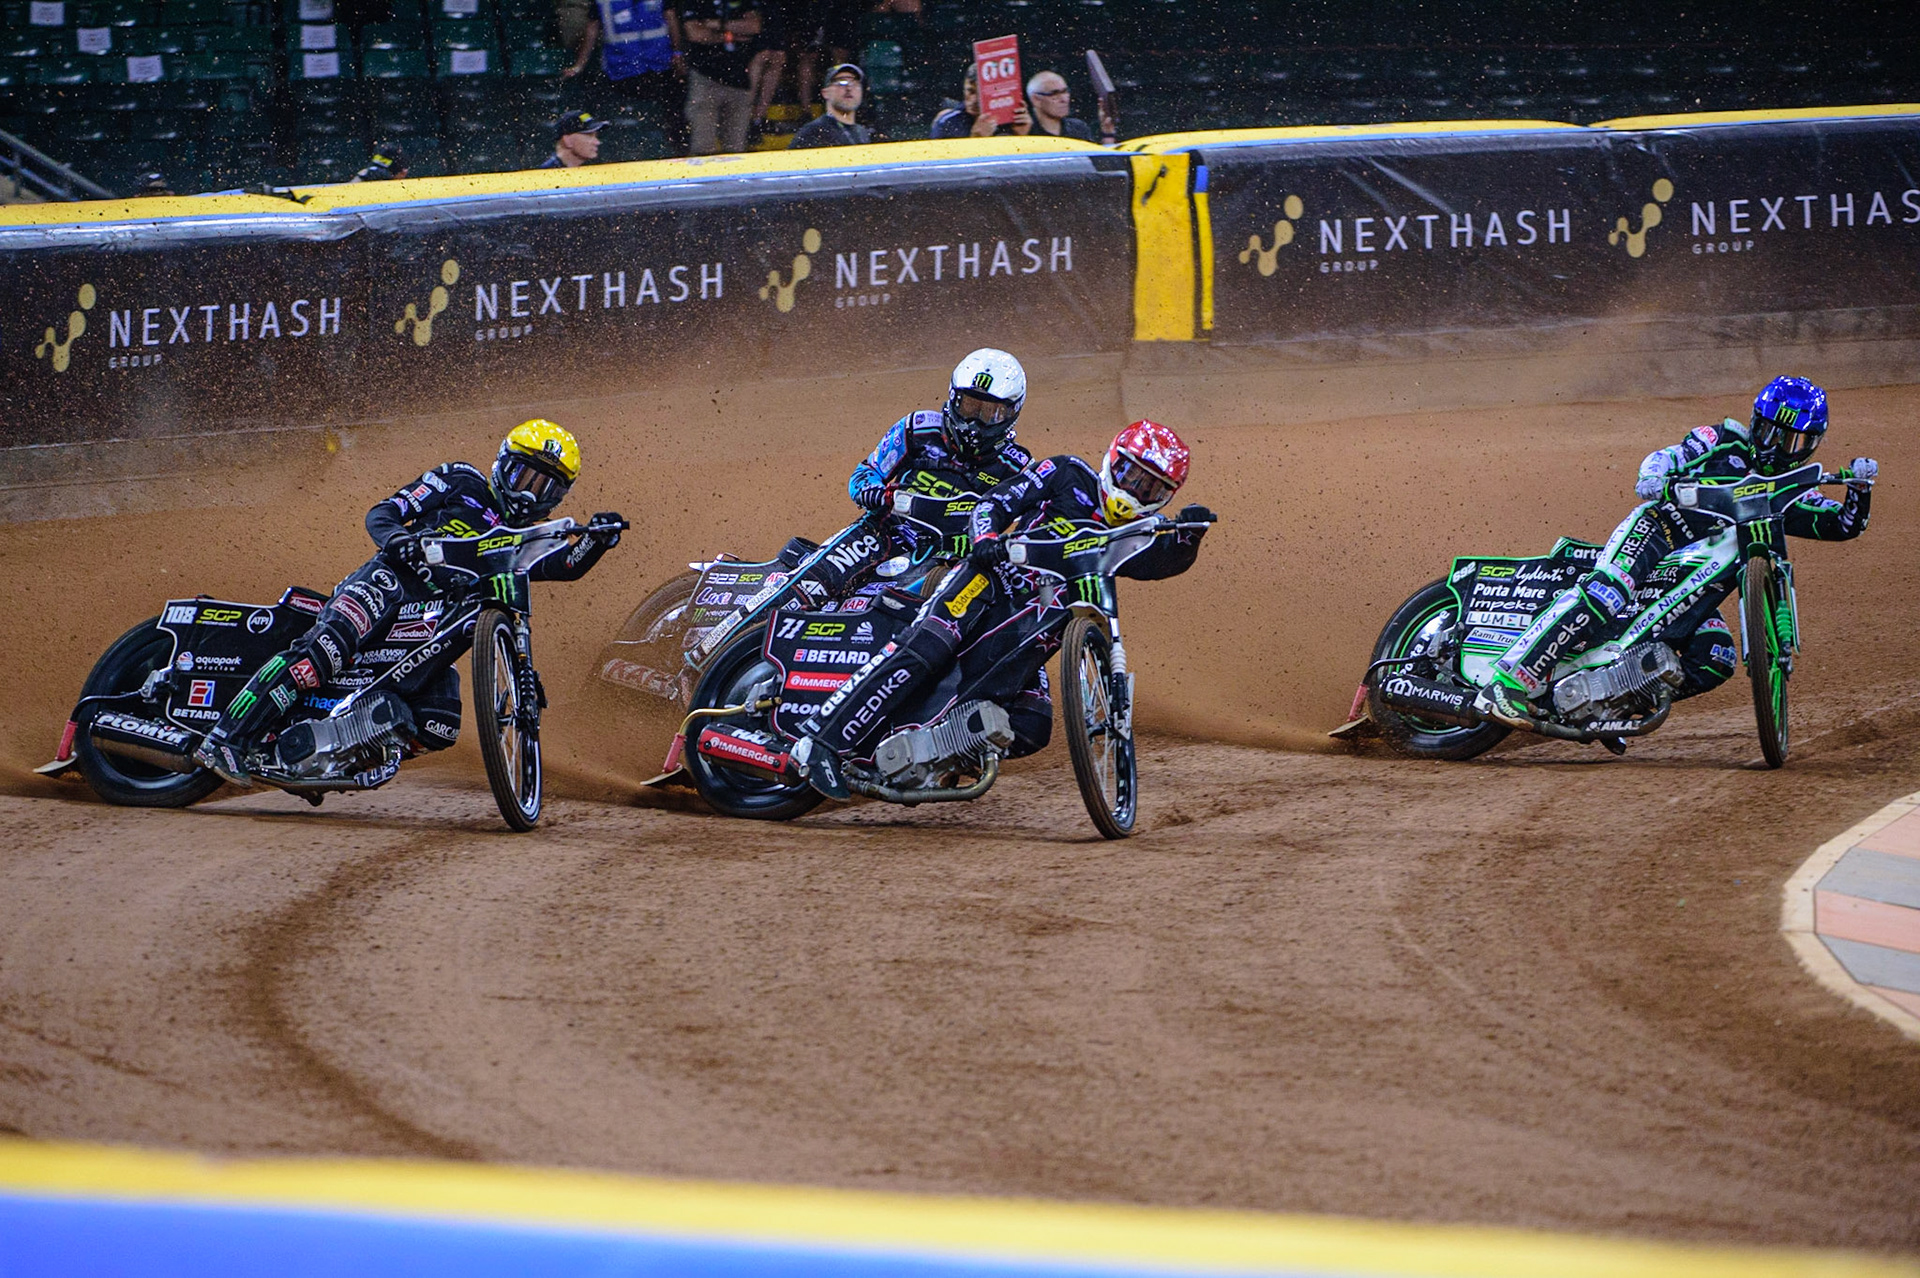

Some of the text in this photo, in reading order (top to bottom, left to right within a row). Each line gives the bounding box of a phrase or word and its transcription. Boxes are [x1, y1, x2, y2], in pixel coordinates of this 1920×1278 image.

[1319, 208, 1572, 255] NEXTHASH
[1692, 240, 1755, 254] GROUP
[835, 236, 1073, 289] NEXTHASH
[1319, 259, 1380, 274] GROUP
[475, 262, 724, 321] NEXTHASH
[834, 293, 892, 309] GROUP
[108, 297, 341, 348] NEXTHASH
[475, 324, 534, 341] GROUP
[108, 354, 163, 369] GROUP
[1733, 483, 1767, 499] SGP
[477, 535, 514, 551] SGP
[1621, 515, 1652, 556] REXER
[1063, 536, 1099, 555] SGP
[825, 534, 880, 575] Nice
[1452, 561, 1476, 584] 692
[1479, 565, 1517, 578] SGP
[1689, 560, 1721, 588] Nice
[1472, 582, 1547, 599] Porta Mare
[1657, 586, 1689, 612] Nice
[1469, 597, 1539, 612] Impeks
[165, 606, 198, 624] 108
[200, 608, 243, 621] SGP
[776, 618, 806, 640] 71
[804, 622, 846, 636] SGP
[1628, 611, 1656, 639] Nice
[1471, 629, 1496, 640] Rami
[1525, 612, 1591, 678] Impeks
[195, 656, 242, 667] aquapark
[807, 649, 871, 665] BETARD
[1411, 685, 1465, 706] MARWIS
[172, 707, 221, 720] BETARD
[718, 741, 776, 766] IMMERGAS
